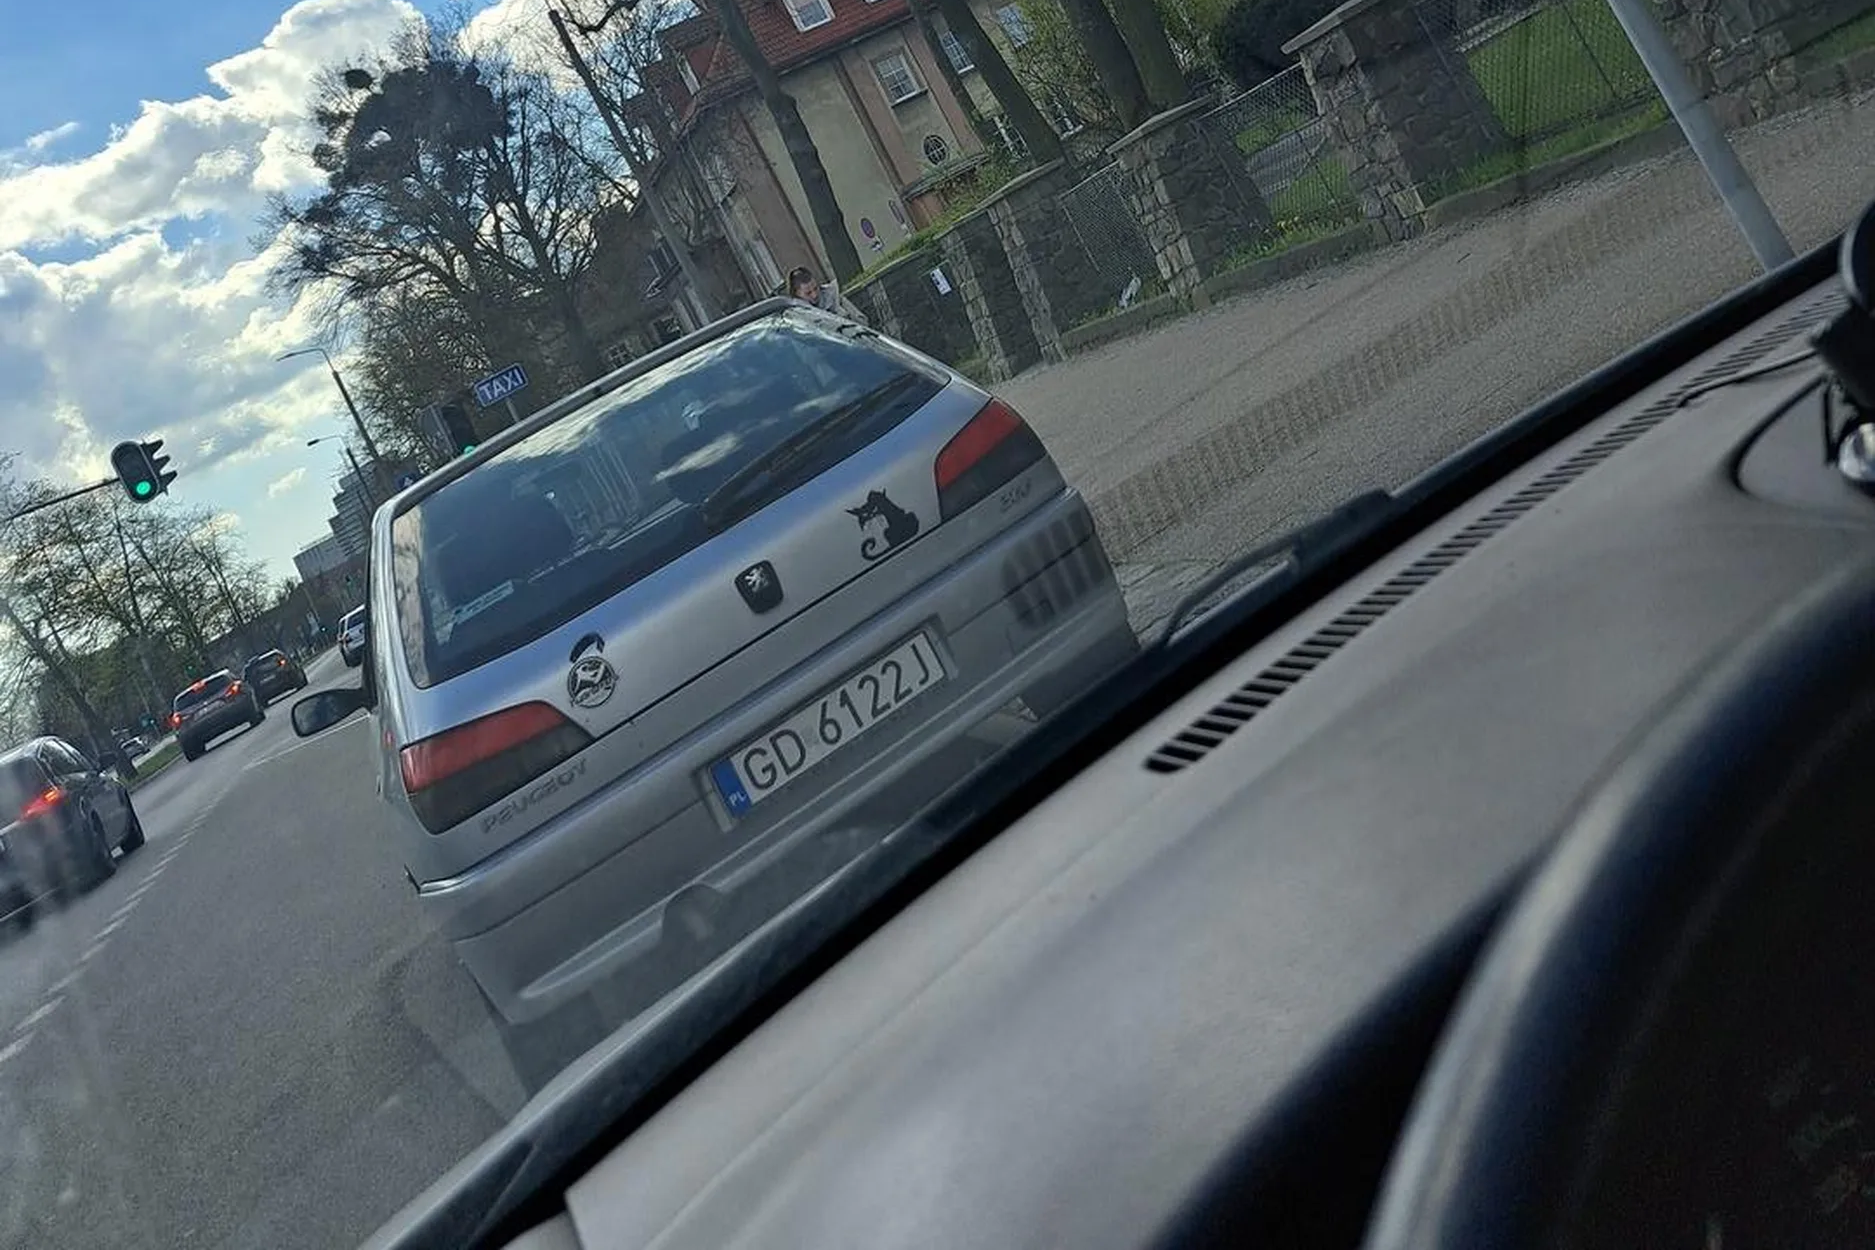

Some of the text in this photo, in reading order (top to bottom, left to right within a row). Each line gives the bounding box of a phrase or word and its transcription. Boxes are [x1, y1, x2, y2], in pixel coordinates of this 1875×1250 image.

[478, 368, 525, 400] TAXI
[743, 643, 930, 790] GD 6122J
[728, 791, 748, 808] PL
